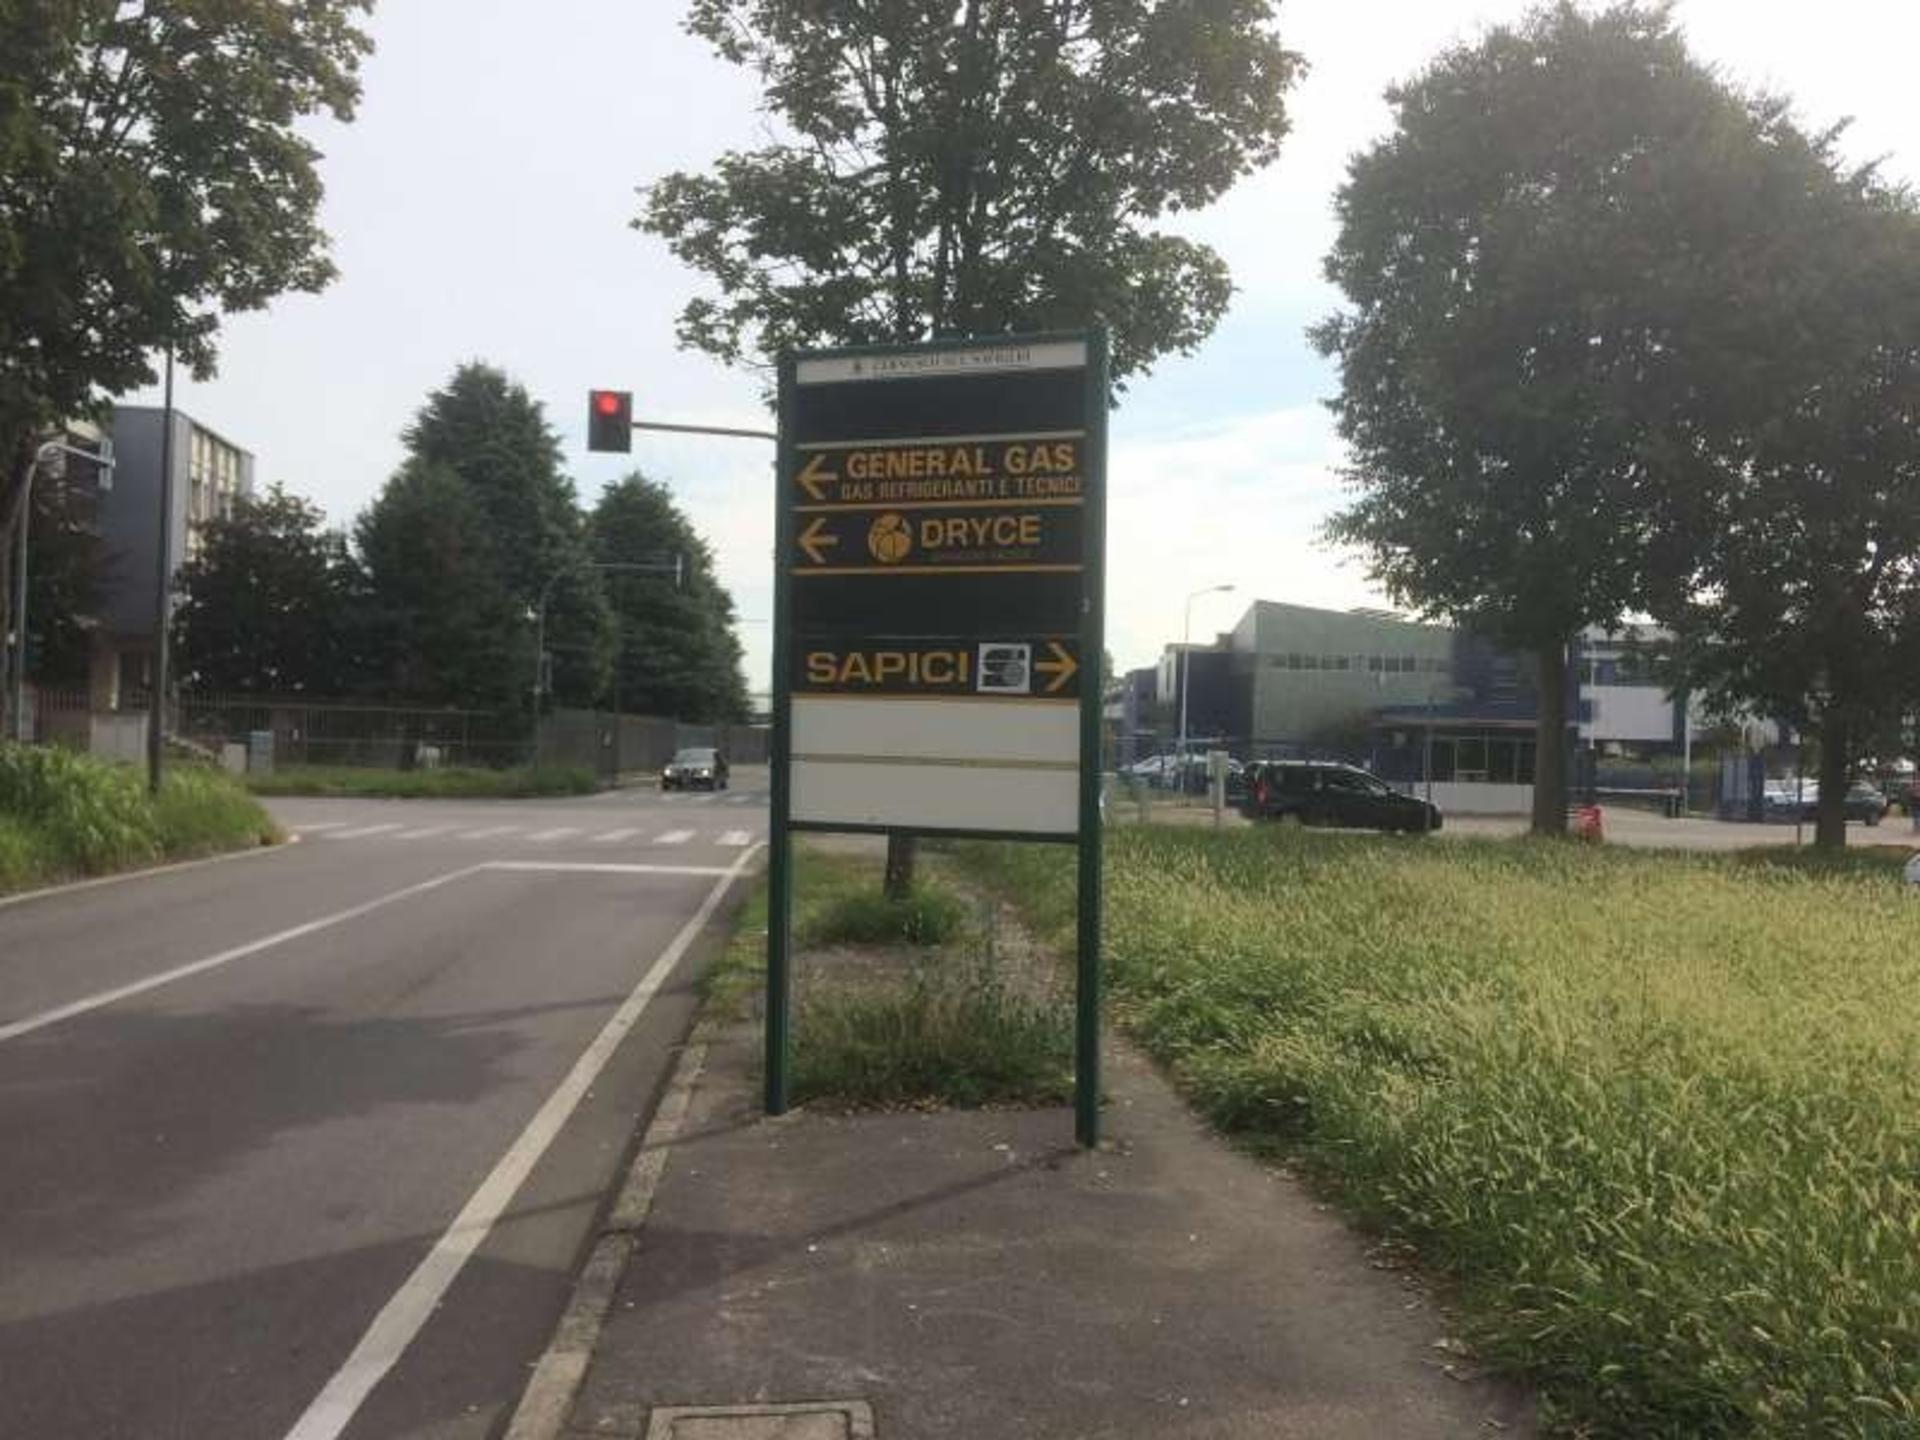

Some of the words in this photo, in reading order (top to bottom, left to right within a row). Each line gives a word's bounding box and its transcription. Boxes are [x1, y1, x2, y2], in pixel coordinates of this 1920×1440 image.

[847, 447, 993, 479] GENERAL
[1004, 444, 1075, 474] GAS
[841, 482, 874, 500] GAS
[921, 515, 1041, 548] DRYCE
[806, 651, 968, 684] SAPICI
